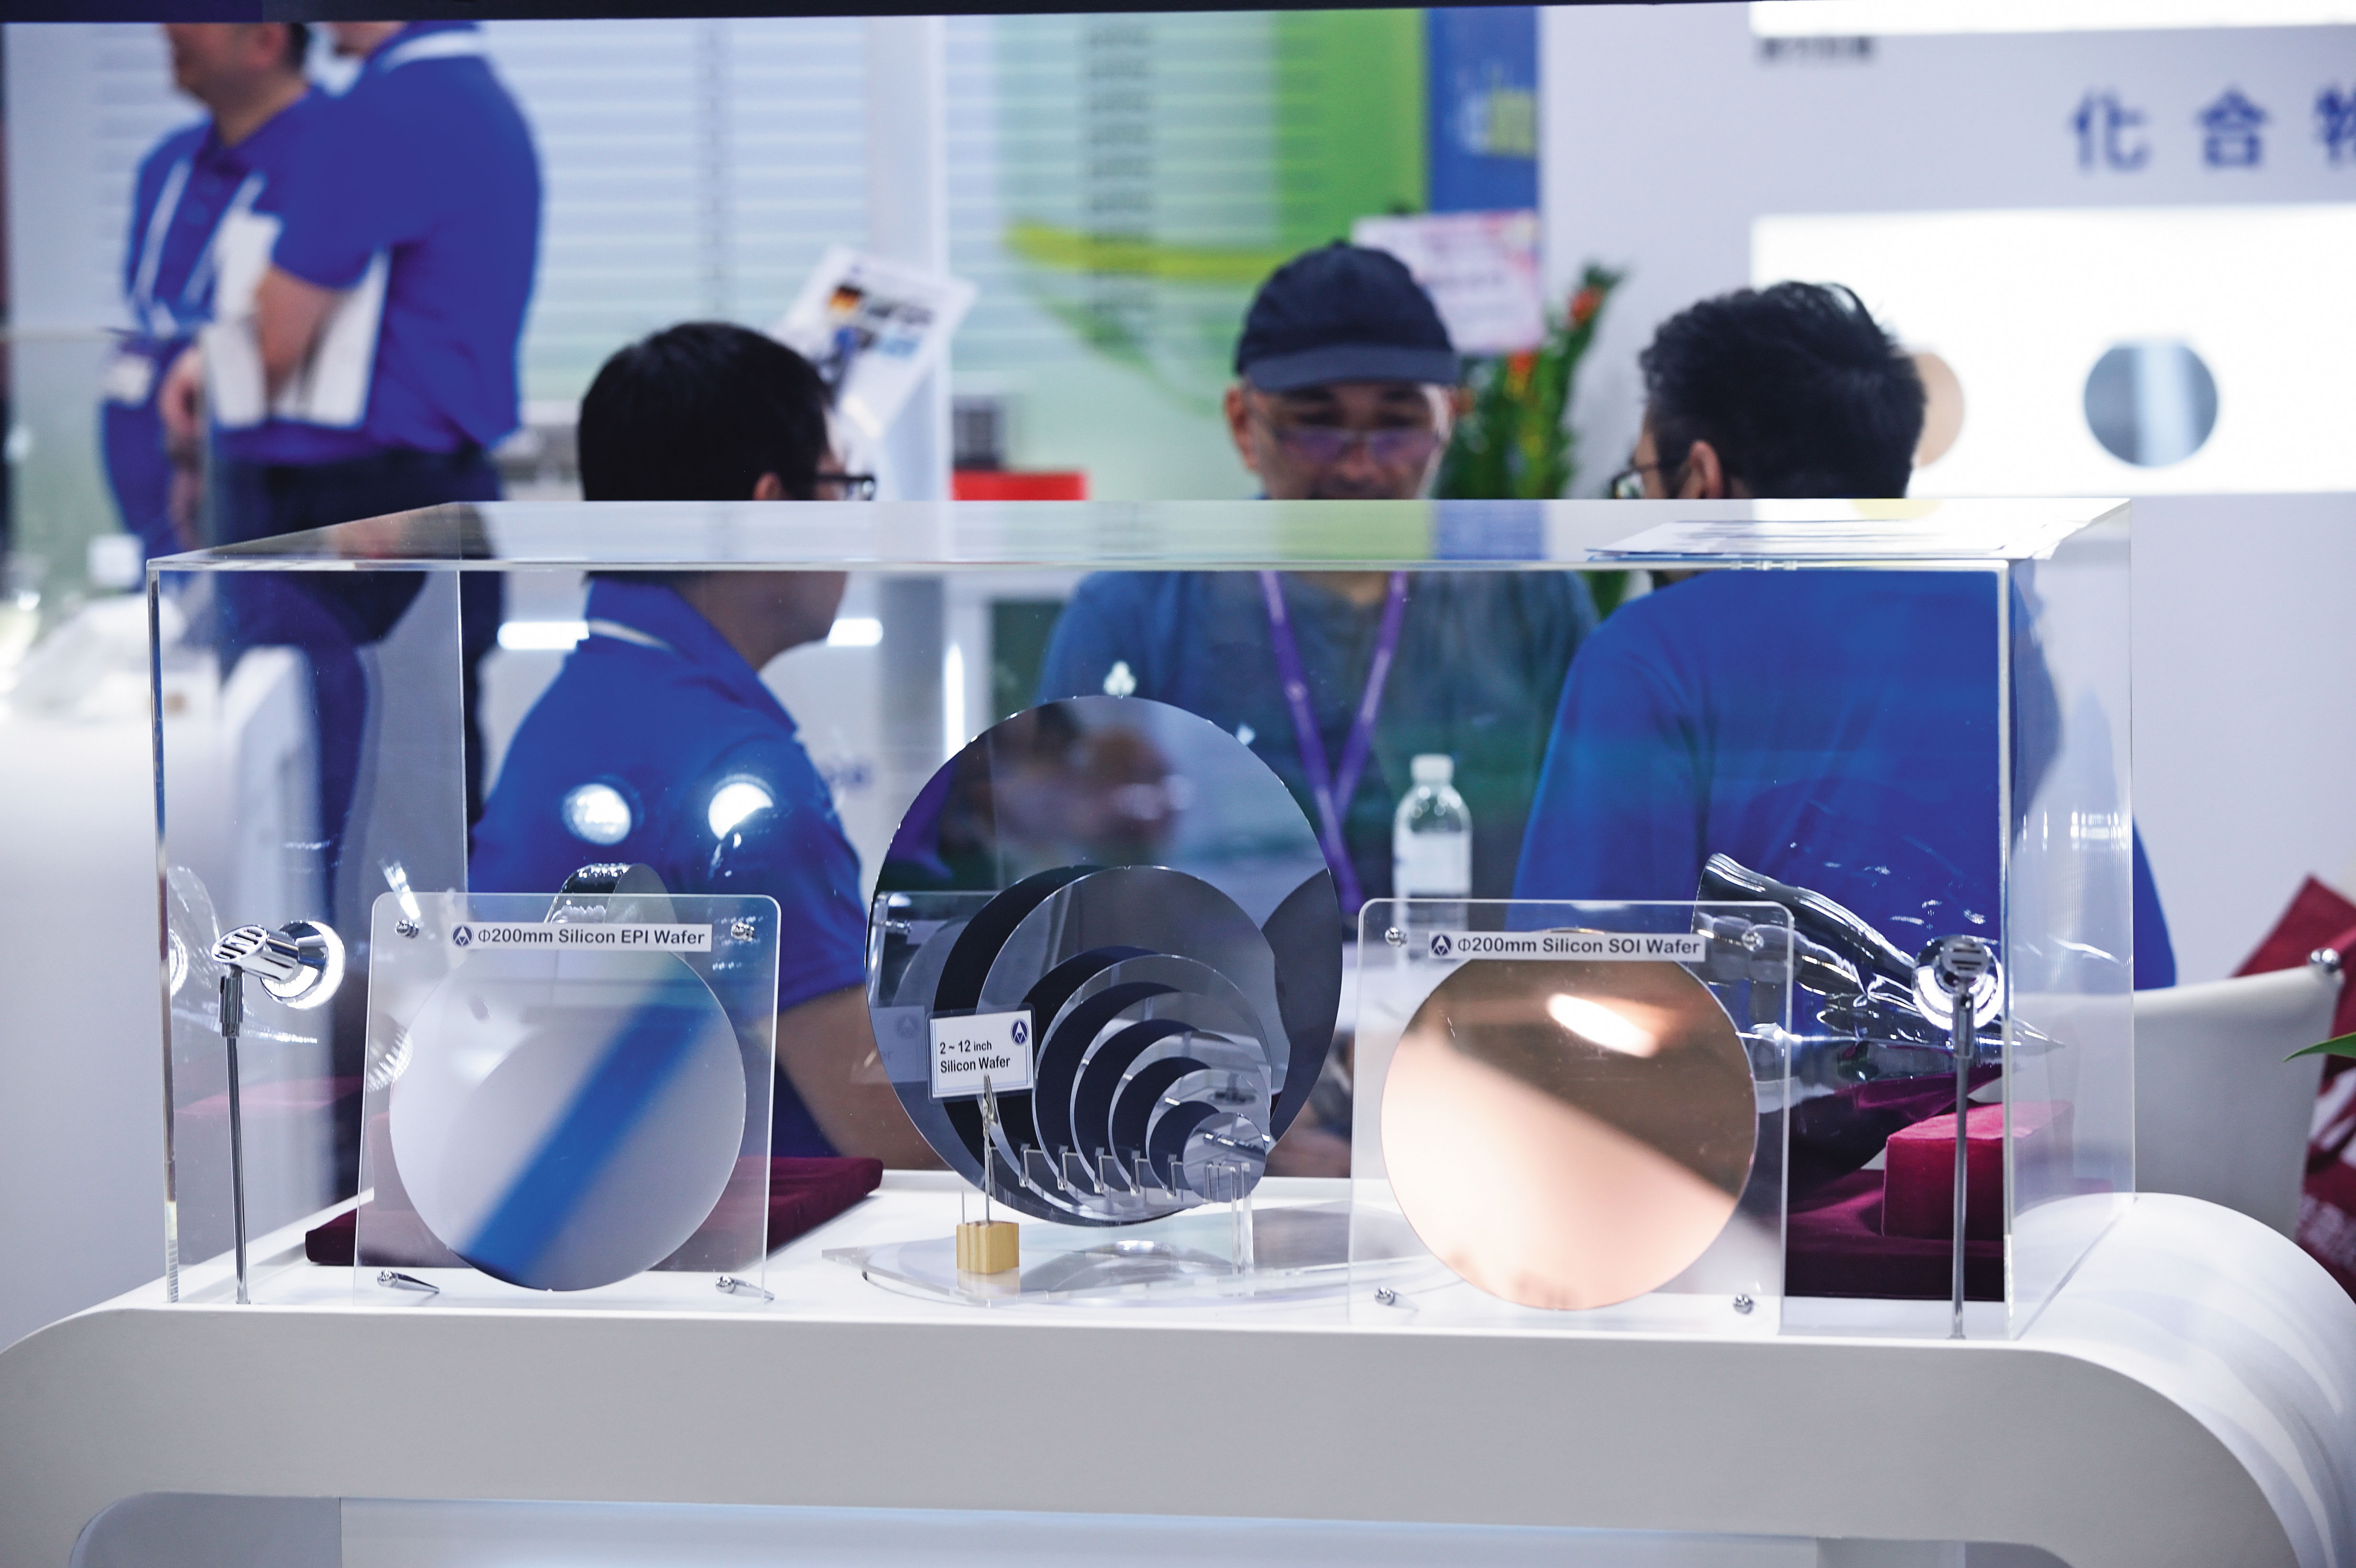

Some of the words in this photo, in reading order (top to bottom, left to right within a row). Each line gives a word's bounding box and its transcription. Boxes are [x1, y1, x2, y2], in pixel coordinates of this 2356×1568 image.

[478, 928, 553, 943] Φ200mm
[558, 928, 615, 943] Silicon
[621, 929, 649, 944] EPI
[654, 929, 705, 944] Wafer
[1458, 937, 1537, 952] Φ200mm
[1542, 937, 1603, 953] Silicon
[1608, 938, 1641, 953] SOI
[1646, 939, 1700, 954] Wafer
[940, 1042, 946, 1055] 2
[958, 1039, 971, 1053] 12
[973, 1040, 993, 1051] inch
[940, 1060, 976, 1074] Silicon
[978, 1055, 1011, 1070] Wafer
